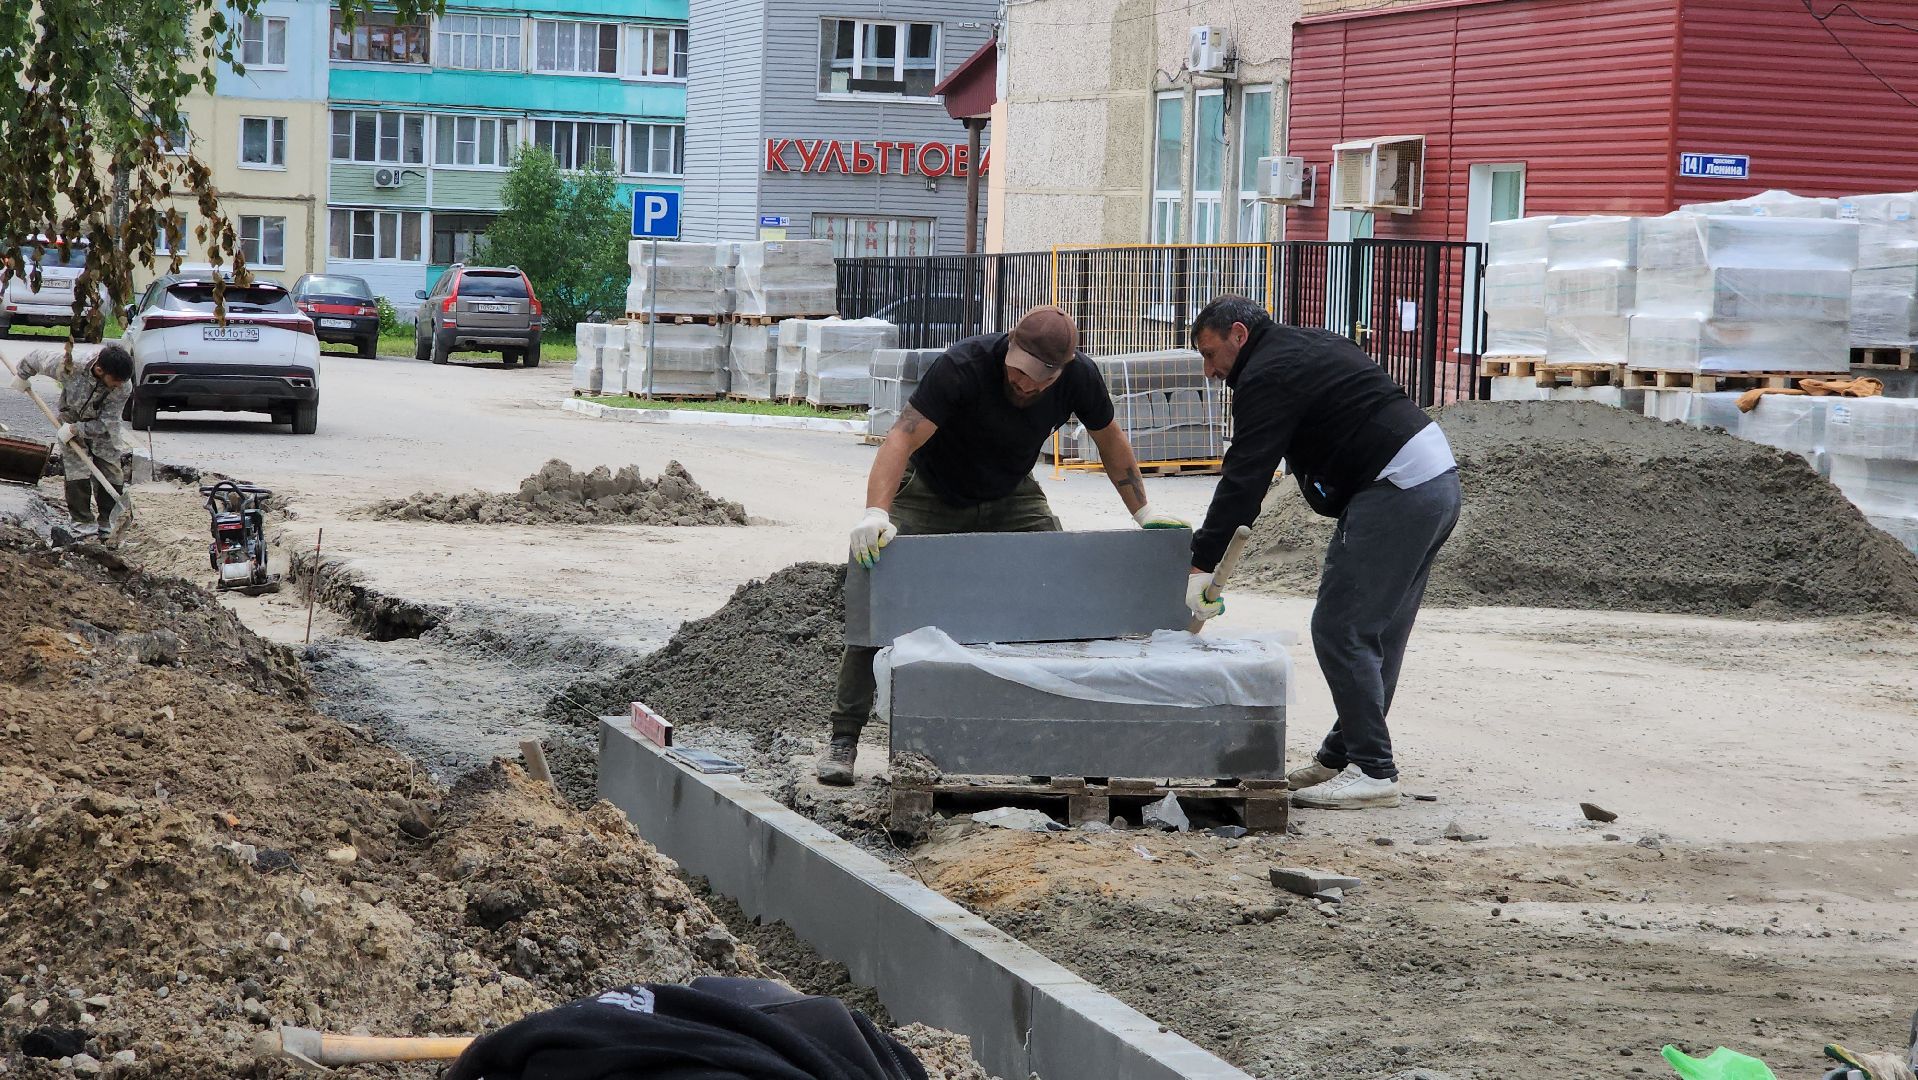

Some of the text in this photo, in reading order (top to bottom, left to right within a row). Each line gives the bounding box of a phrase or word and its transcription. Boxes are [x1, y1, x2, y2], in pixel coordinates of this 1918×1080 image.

[1685, 157, 1697, 173] 14
[1705, 164, 1742, 175] Ленина
[644, 195, 668, 233] P
